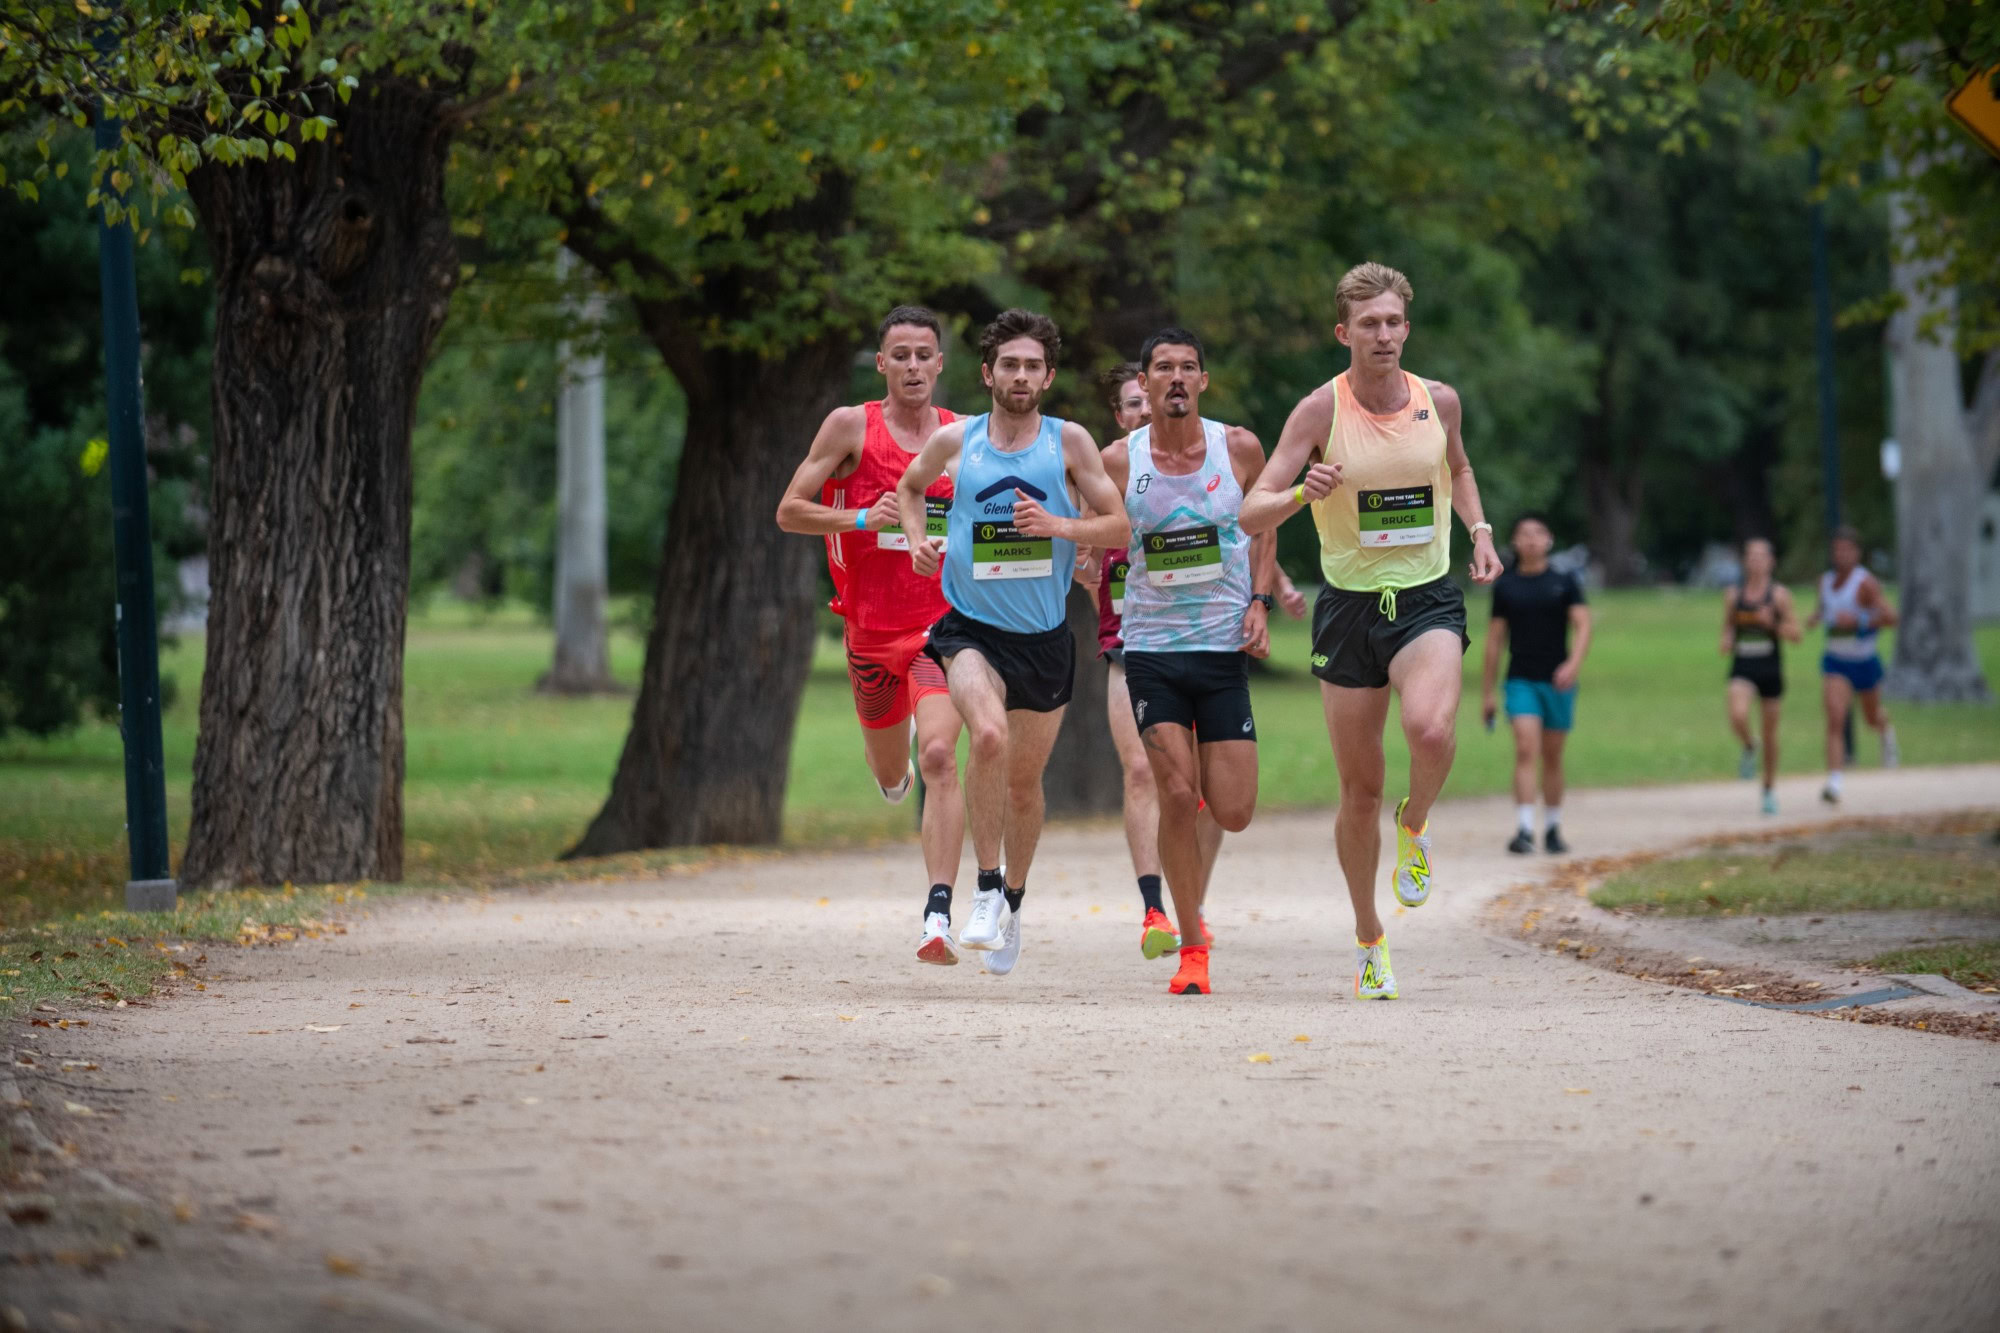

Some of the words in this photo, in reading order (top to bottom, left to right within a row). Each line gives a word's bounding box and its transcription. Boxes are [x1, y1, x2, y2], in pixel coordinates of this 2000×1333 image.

[984, 502, 1016, 514] Glenh
[1382, 515, 1416, 525] BRUCE
[994, 547, 1032, 557] MARKS
[1163, 554, 1203, 565] CLARKE
